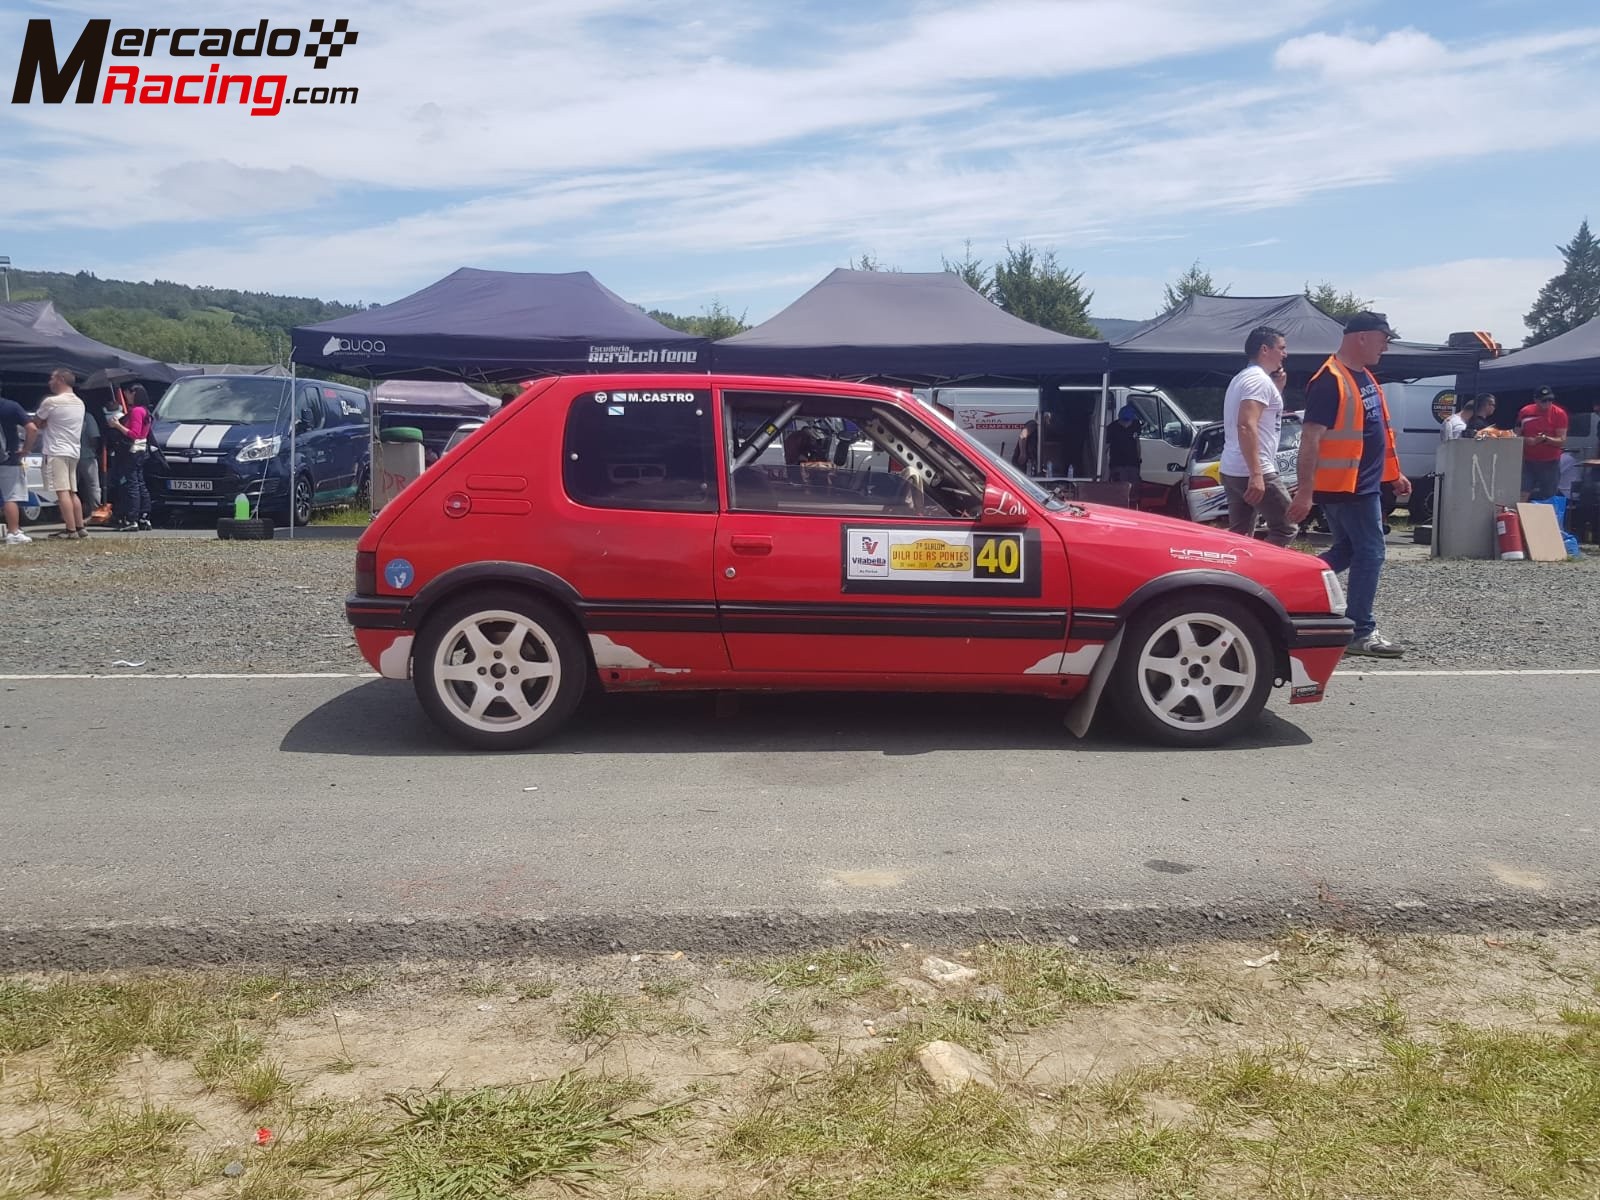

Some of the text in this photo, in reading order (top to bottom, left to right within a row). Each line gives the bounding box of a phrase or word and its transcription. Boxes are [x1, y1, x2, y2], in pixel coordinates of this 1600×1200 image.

[628, 393, 695, 402] M.CASTRO
[1471, 454, 1497, 502] N
[173, 480, 193, 489] 1753
[851, 556, 887, 565] Vilabella
[913, 551, 923, 560] DE
[926, 552, 937, 560] AS
[939, 552, 969, 562] PONTES
[976, 538, 1019, 574] 40
